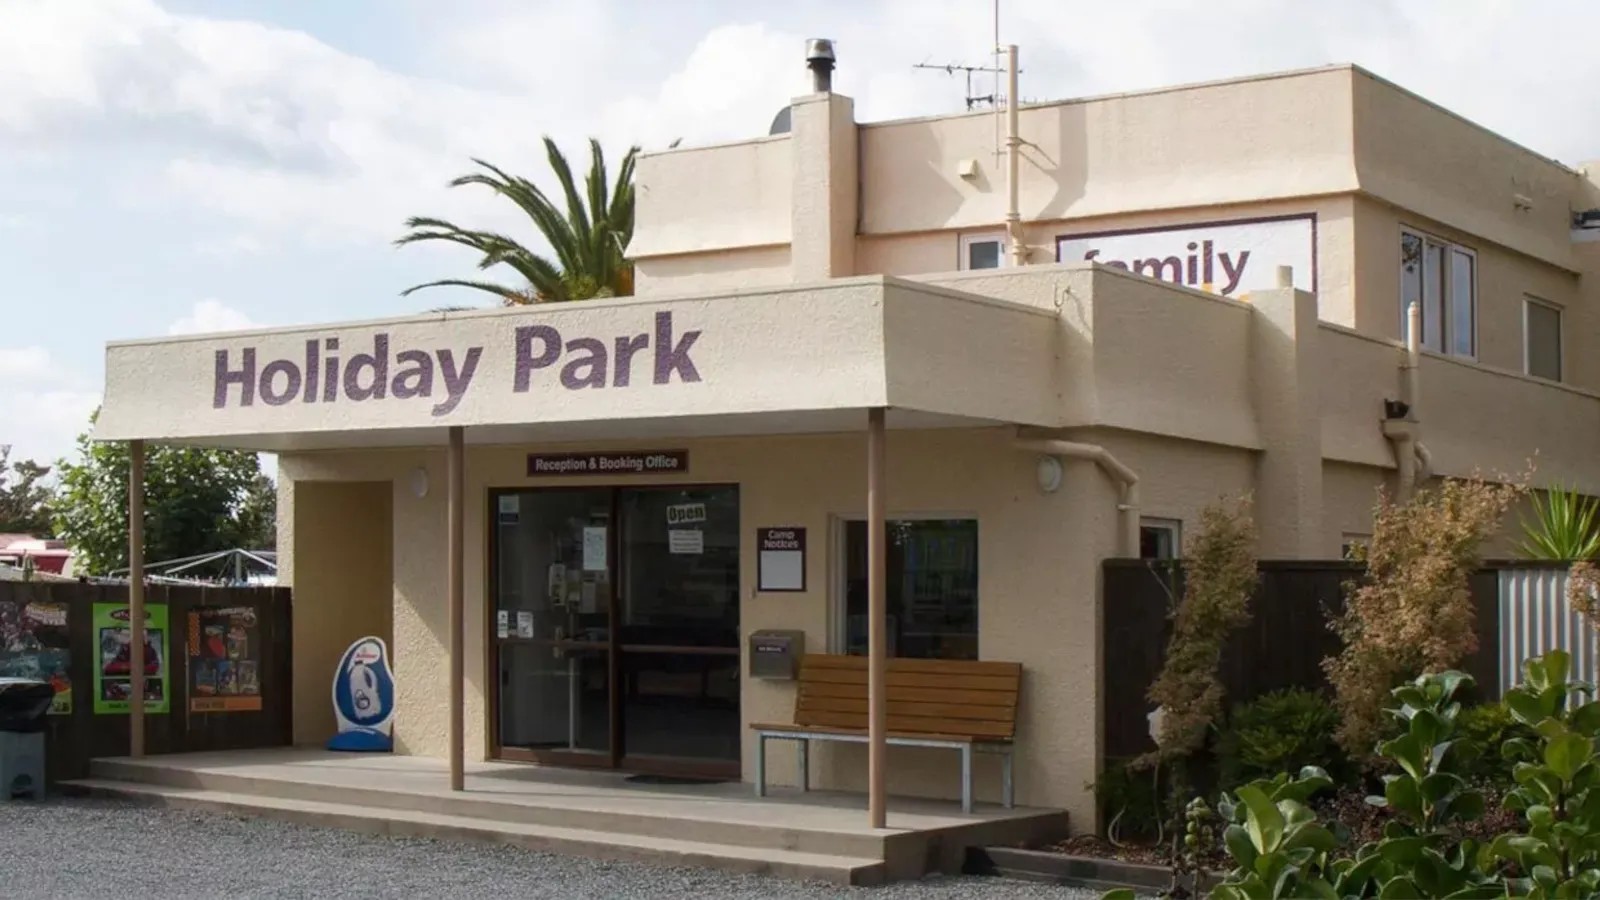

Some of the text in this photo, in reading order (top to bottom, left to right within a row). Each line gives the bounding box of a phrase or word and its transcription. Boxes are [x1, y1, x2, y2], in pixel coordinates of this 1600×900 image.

[1084, 239, 1250, 295] mily
[213, 310, 702, 417] Holiday Park
[535, 455, 678, 472] Reception & Booking Office
[669, 506, 704, 521] Open
[768, 529, 795, 540] Camp
[763, 539, 799, 549] Notices
